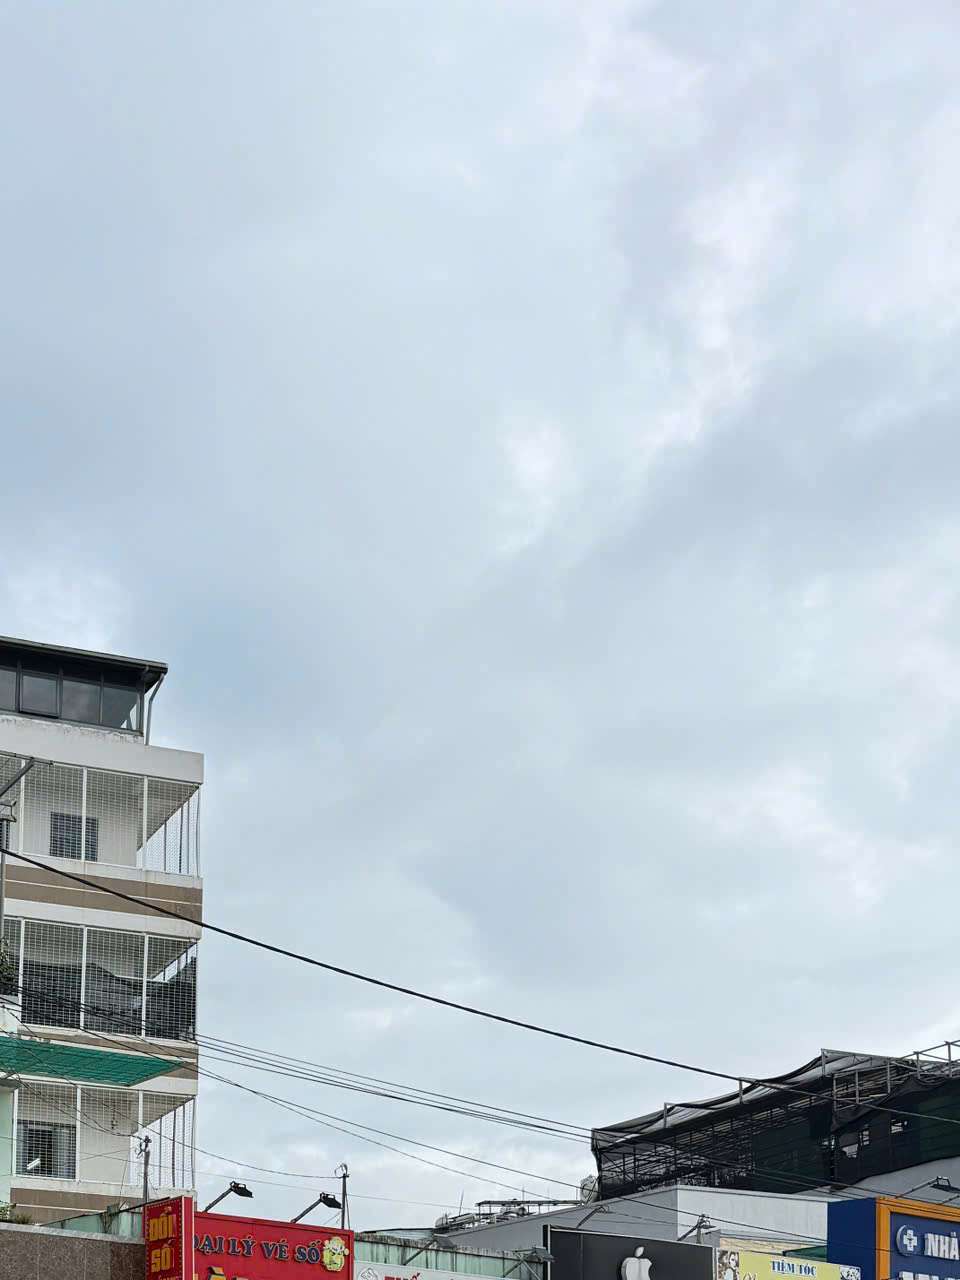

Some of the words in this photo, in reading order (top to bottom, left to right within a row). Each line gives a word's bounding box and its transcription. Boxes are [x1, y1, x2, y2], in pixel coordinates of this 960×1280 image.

[149, 1207, 174, 1241] ĐỔI
[151, 1240, 171, 1273] SỐ
[229, 1235, 256, 1257] LÝ
[262, 1239, 290, 1260] VÉ
[295, 1240, 321, 1263] SỐ
[924, 1231, 960, 1261] NHÀ
[770, 1260, 795, 1274] TIỆM
[797, 1263, 817, 1276] TÓC
